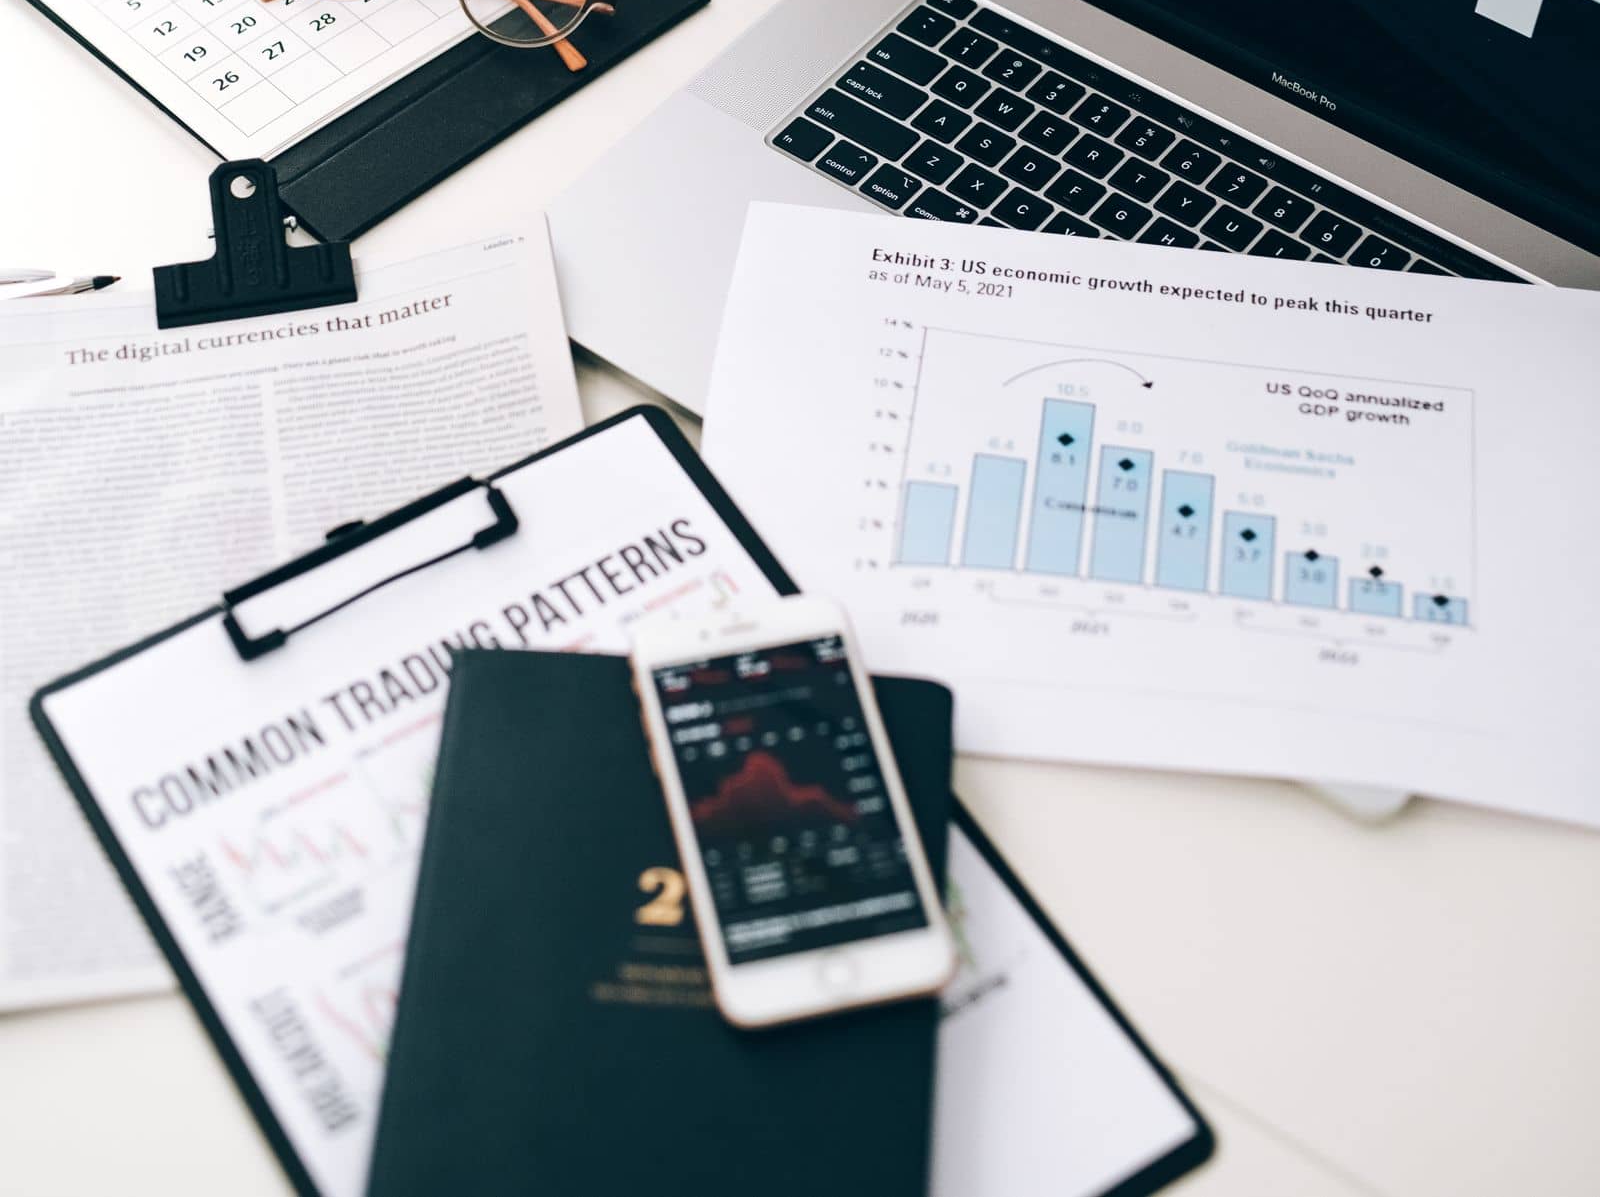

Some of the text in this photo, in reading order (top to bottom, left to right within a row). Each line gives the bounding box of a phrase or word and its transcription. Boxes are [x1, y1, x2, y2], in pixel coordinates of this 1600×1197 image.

[153, 20, 178, 37] 12
[183, 46, 208, 63] 19
[230, 16, 257, 35] 20
[212, 13, 336, 91] 26 27 28
[875, 49, 891, 60] tab
[961, 47, 969, 55] 1
[1001, 68, 1014, 79] 2
[846, 77, 884, 100] caps lock
[954, 81, 967, 92] Q
[1271, 71, 1337, 111] MacBook Pro
[1046, 91, 1057, 101] 3
[814, 106, 835, 121] shift
[998, 102, 1014, 114] W
[934, 116, 947, 127] A
[1090, 114, 1102, 124] 4
[1042, 126, 1055, 138] E
[782, 134, 793, 144] fn
[979, 138, 992, 149] S
[1135, 137, 1147, 147] 5
[1087, 150, 1100, 161] R
[926, 156, 940, 167] Z
[1023, 162, 1037, 172] D
[1181, 160, 1193, 170] 6
[825, 158, 856, 178] control
[1135, 173, 1147, 184] T
[970, 179, 984, 191] X
[1069, 185, 1083, 195] F
[1227, 183, 1240, 193] 7
[871, 183, 899, 201] option
[1181, 197, 1193, 208] Y
[914, 206, 943, 222] comm
[1016, 204, 1029, 215] C
[1274, 208, 1286, 218] 8
[1115, 210, 1128, 221] G
[1225, 221, 1240, 233] U
[1161, 234, 1175, 245] H
[1321, 232, 1333, 242] 9
[1370, 257, 1382, 267] 0
[868, 269, 1013, 298] as of May 5, 2021
[872, 248, 1432, 323] Exhibit 3: US economic growth expected to peak this quarter
[64, 293, 453, 365] The digital currencies that matter
[1057, 383, 1089, 397] 10.5
[1266, 382, 1444, 412] US QoQ annualized
[1298, 403, 1410, 425] GDP growth
[1113, 477, 1138, 491] 7.0
[1172, 524, 1197, 538] 4.7
[129, 712, 327, 833] COMMON
[501, 518, 708, 649] PATTERNS
[633, 867, 685, 926] 2
